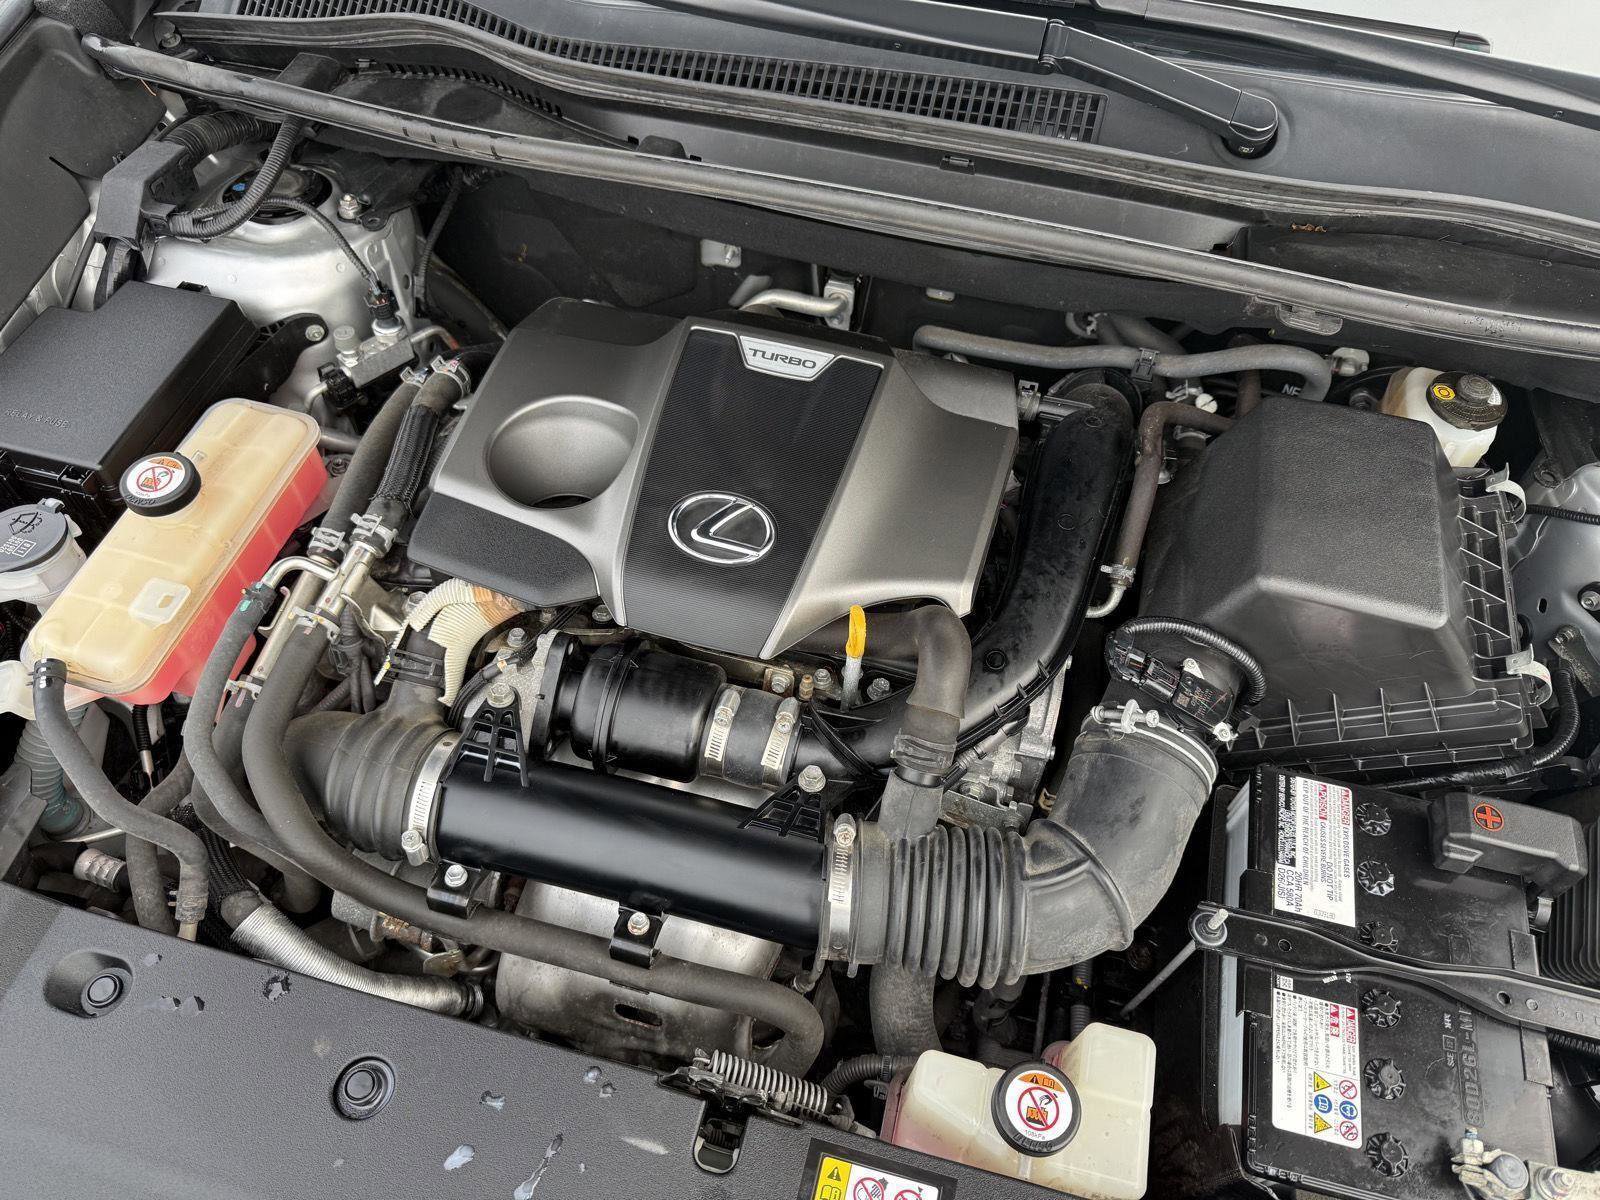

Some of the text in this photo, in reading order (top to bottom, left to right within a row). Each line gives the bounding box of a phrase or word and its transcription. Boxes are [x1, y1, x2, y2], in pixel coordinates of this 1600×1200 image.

[749, 348, 817, 369] TURBO
[4, 407, 34, 421] RELAY
[43, 416, 70, 429] FUSE
[1302, 806, 1309, 814] OF
[1319, 792, 1327, 818] POISON
[1342, 796, 1350, 825] DANGER
[1302, 847, 1308, 855] OF
[1326, 862, 1333, 873] DO
[1286, 870, 1294, 886] CCA
[1286, 888, 1294, 906] 580A
[1013, 1132, 1055, 1152] DENSO
